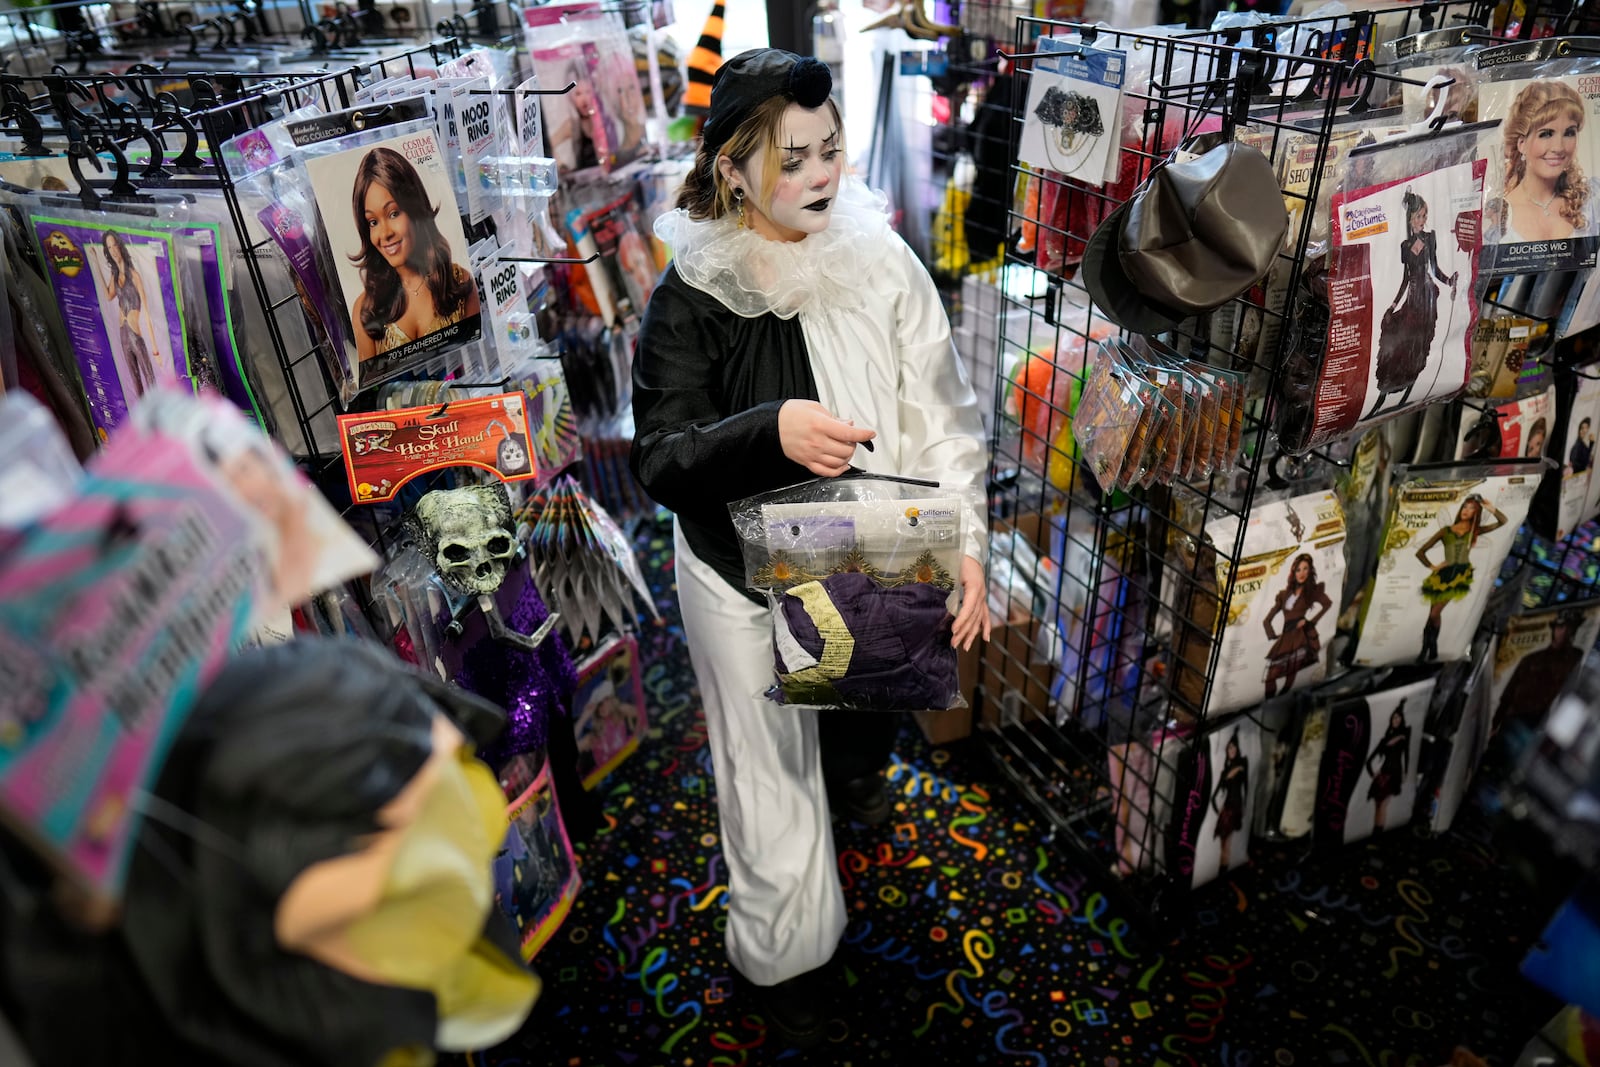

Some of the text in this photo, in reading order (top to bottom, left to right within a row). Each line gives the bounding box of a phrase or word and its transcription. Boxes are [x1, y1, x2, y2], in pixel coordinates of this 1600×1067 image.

[462, 101, 489, 127] MOOD
[294, 126, 347, 145] WIG COLLECTION
[467, 119, 489, 143] RING
[402, 135, 432, 151] COSTUME
[405, 144, 436, 161] CULTURE
[1355, 205, 1382, 219] California
[1352, 213, 1387, 231] Costumes
[1509, 241, 1568, 255] DUCHESS WIG
[490, 264, 517, 293] MOOD
[495, 280, 517, 306] RING
[388, 350, 403, 361] 70's
[403, 333, 443, 356] FEATHERED
[443, 326, 459, 338] WIG
[418, 420, 458, 441] Skull
[395, 431, 485, 456] Hook Hand
[1399, 511, 1437, 522] Sprocket
[1406, 520, 1428, 529] Pixie
